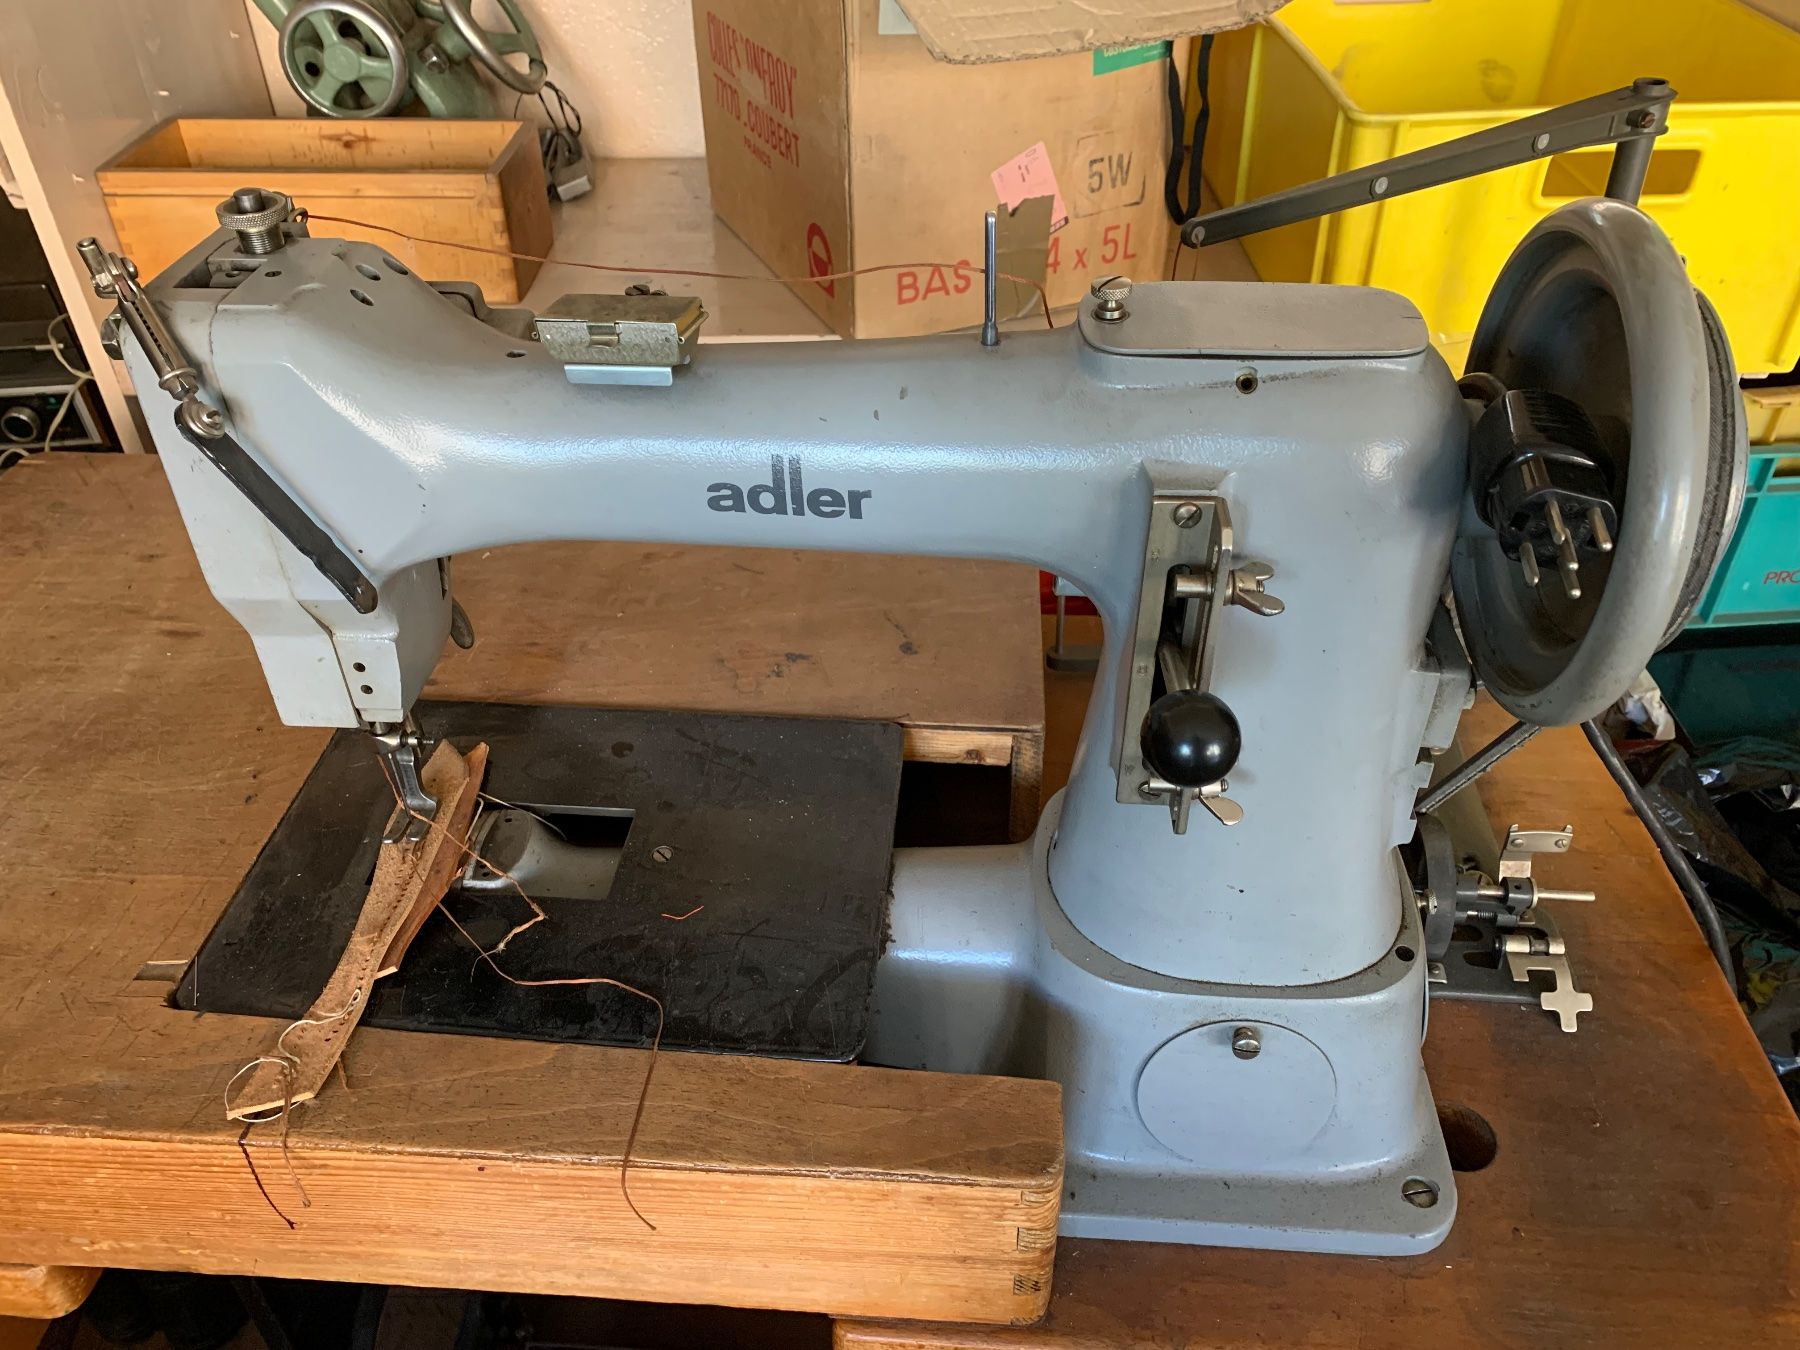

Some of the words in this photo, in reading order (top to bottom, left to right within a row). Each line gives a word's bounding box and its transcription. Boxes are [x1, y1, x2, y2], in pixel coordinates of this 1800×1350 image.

[743, 135, 772, 169] FRANCE
[1088, 152, 1133, 193] 5W
[1101, 223, 1137, 264] 5L
[707, 454, 872, 519] adler
